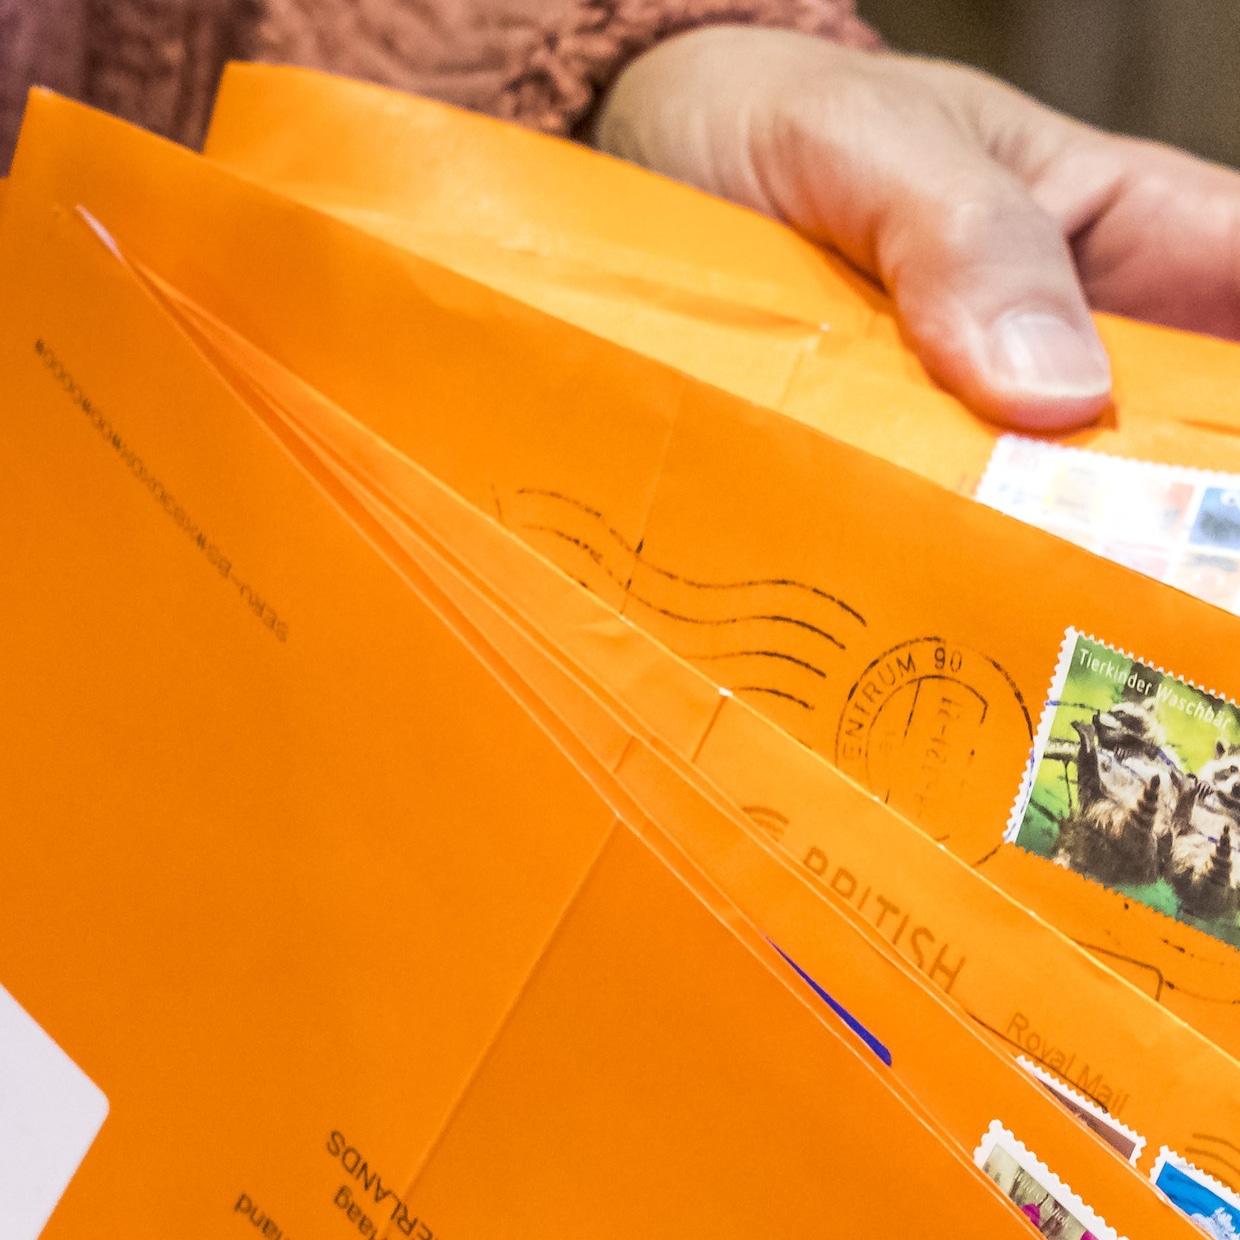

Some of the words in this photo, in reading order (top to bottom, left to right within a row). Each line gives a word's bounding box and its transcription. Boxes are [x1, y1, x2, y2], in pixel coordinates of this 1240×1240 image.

[933, 647, 963, 673] 90
[1079, 648, 1153, 696] Tierkinder
[1155, 683, 1232, 731] Waschbär
[1006, 1012, 1077, 1077] Royal
[1075, 1063, 1130, 1116] Mail
